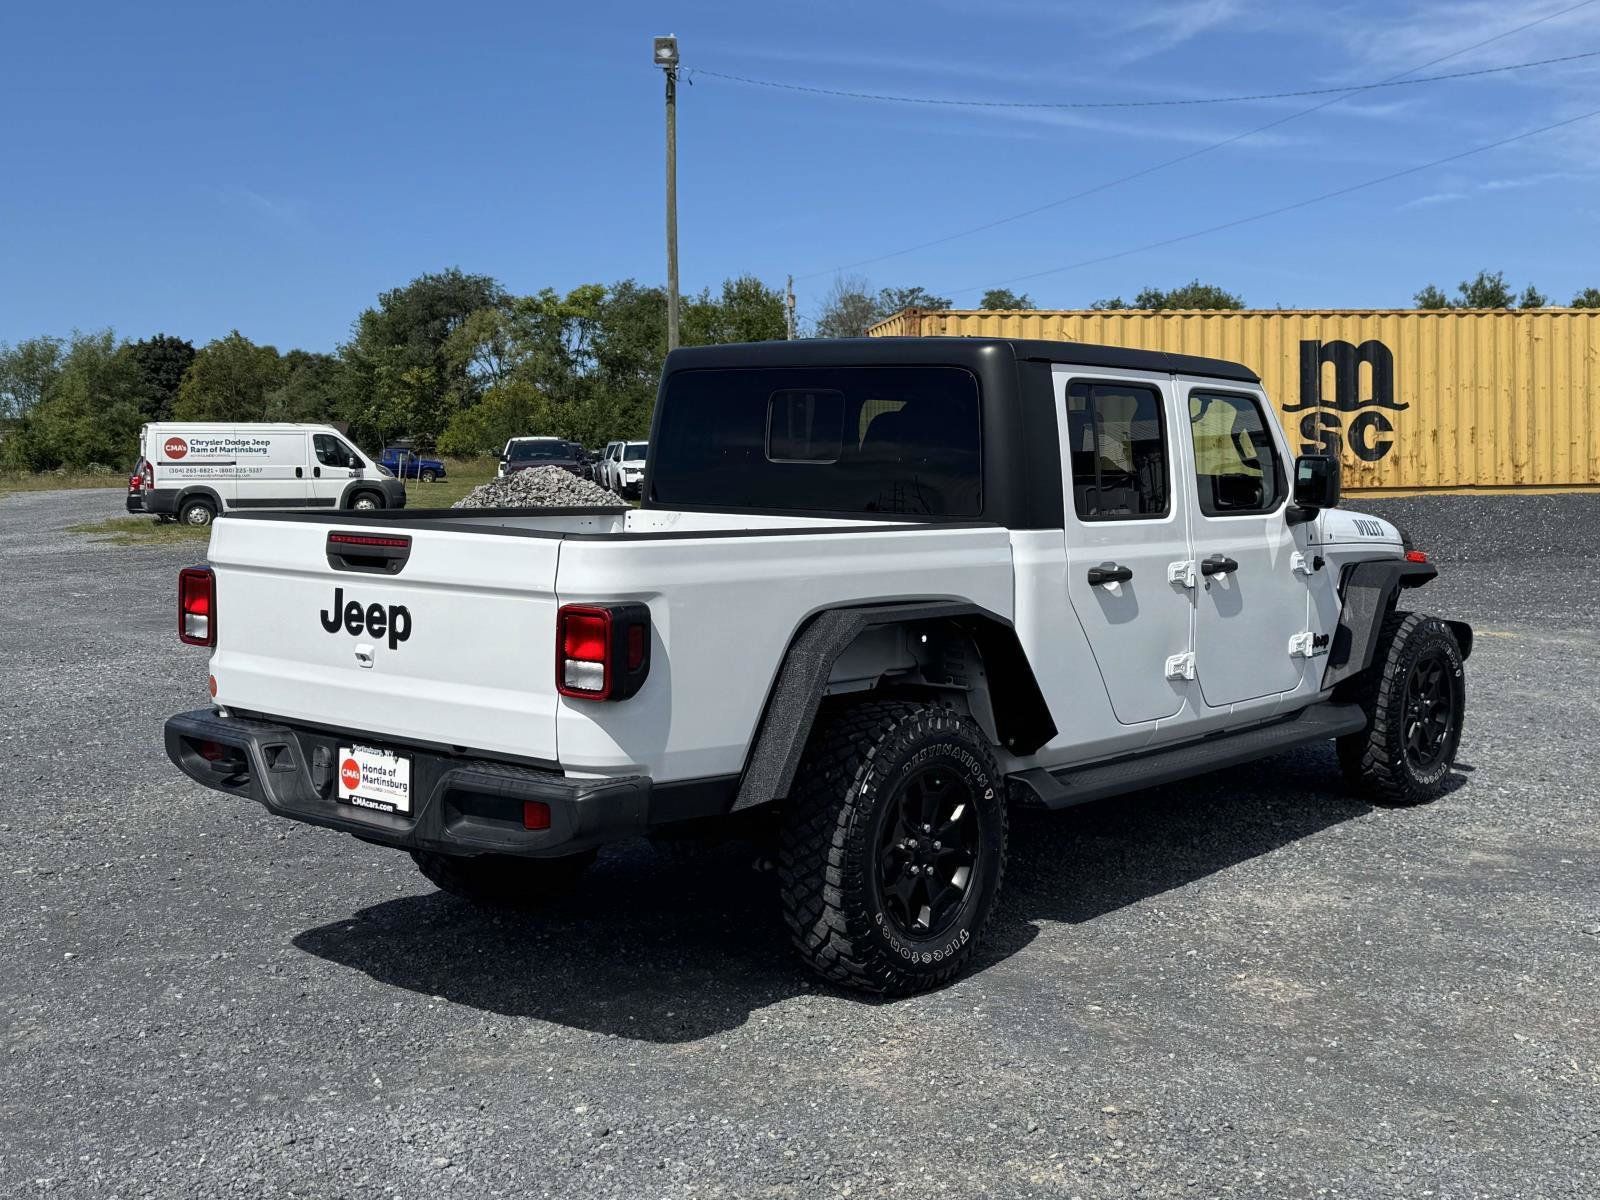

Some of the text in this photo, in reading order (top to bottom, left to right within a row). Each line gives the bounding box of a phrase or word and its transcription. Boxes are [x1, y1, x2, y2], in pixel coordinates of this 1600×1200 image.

[165, 444, 187, 452] CMA's
[190, 439, 224, 448] Chrysler
[225, 439, 251, 447] Dodge
[219, 446, 267, 455] Martinsburg
[1351, 519, 1385, 536] WILLYS
[320, 588, 412, 650] Jeep
[362, 762, 397, 777] Honda of
[902, 743, 988, 787] DESTINATION
[342, 768, 360, 780] CMA's
[362, 774, 408, 793] Martinsburg
[352, 797, 393, 812] CMAcars.com
[882, 925, 970, 965] Firestone
